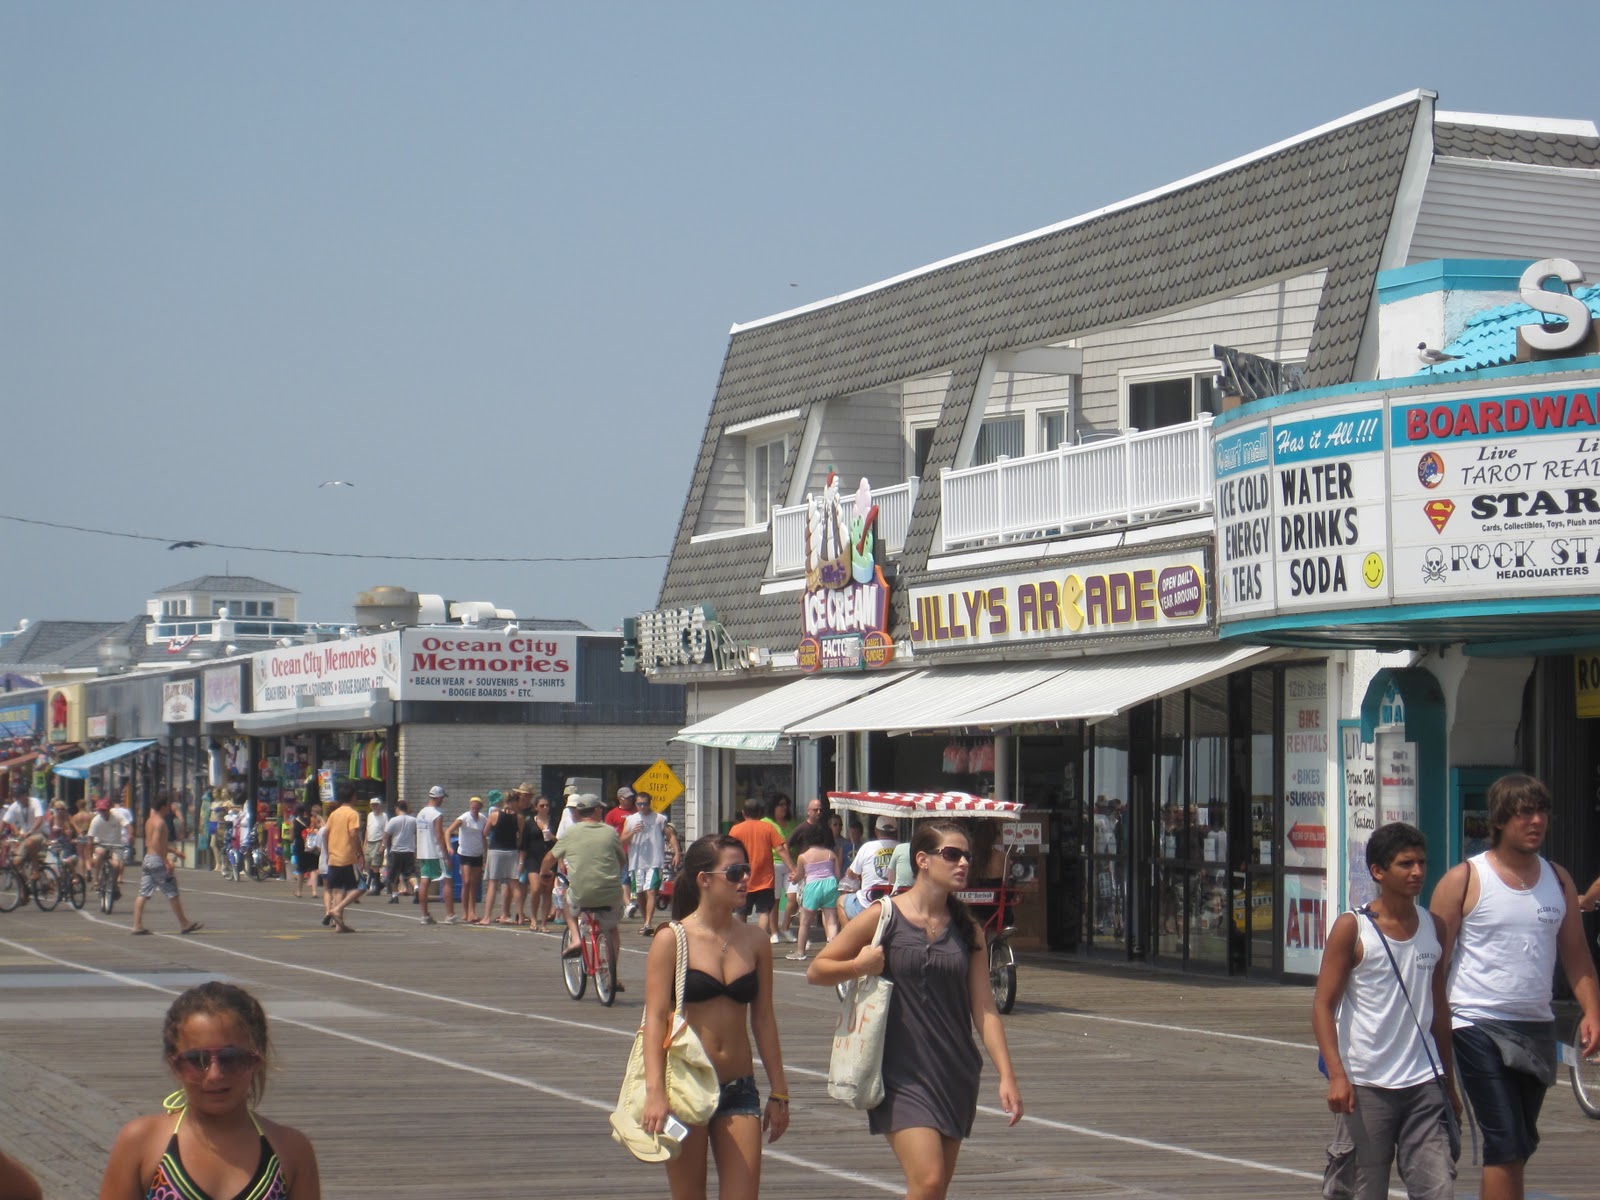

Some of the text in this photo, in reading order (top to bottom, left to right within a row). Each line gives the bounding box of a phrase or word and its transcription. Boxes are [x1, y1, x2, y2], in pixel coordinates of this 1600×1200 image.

[1407, 392, 1600, 440] BOARDWA
[1276, 429, 1305, 454] Has
[1309, 429, 1322, 449] it
[1325, 421, 1353, 448] All
[1477, 446, 1518, 461] Live
[1281, 462, 1354, 507] WATER
[1461, 461, 1538, 485] TAROT
[1220, 473, 1269, 519] ICE COLD
[1281, 507, 1359, 553] DRINKS
[1482, 523, 1503, 533] Cards,
[1504, 520, 1545, 532] Collectibles,
[1547, 519, 1565, 529] Toys,
[1567, 517, 1586, 527] Plush
[1225, 517, 1270, 561] ENERGY
[1451, 536, 1600, 572] ROCK ST
[1162, 569, 1193, 591] OPEN DAILY
[1232, 563, 1263, 603] TEAS
[1290, 555, 1348, 597] SODA
[1496, 566, 1589, 580] HEADQUARTERS
[804, 584, 878, 636] ICE CREAM
[1161, 586, 1199, 610] YEAR AROUND
[910, 587, 1009, 642] JILLY'S
[422, 637, 558, 657] Ocean City
[271, 644, 377, 679] Ocean City Memories
[411, 653, 570, 673] Memories
[415, 676, 565, 687] BEACH WEAR SOUVENIRS T-SHIRTS
[448, 688, 534, 698] BOOGIE BOARDS ETC.
[1289, 680, 1327, 697] 12th Street
[1299, 709, 1320, 729] BIKE
[1287, 734, 1328, 753] RENTALS
[649, 783, 668, 792] STEPS
[1297, 769, 1320, 785] BIKES
[1289, 791, 1325, 807] SURREYS
[1286, 898, 1327, 950] ATM
